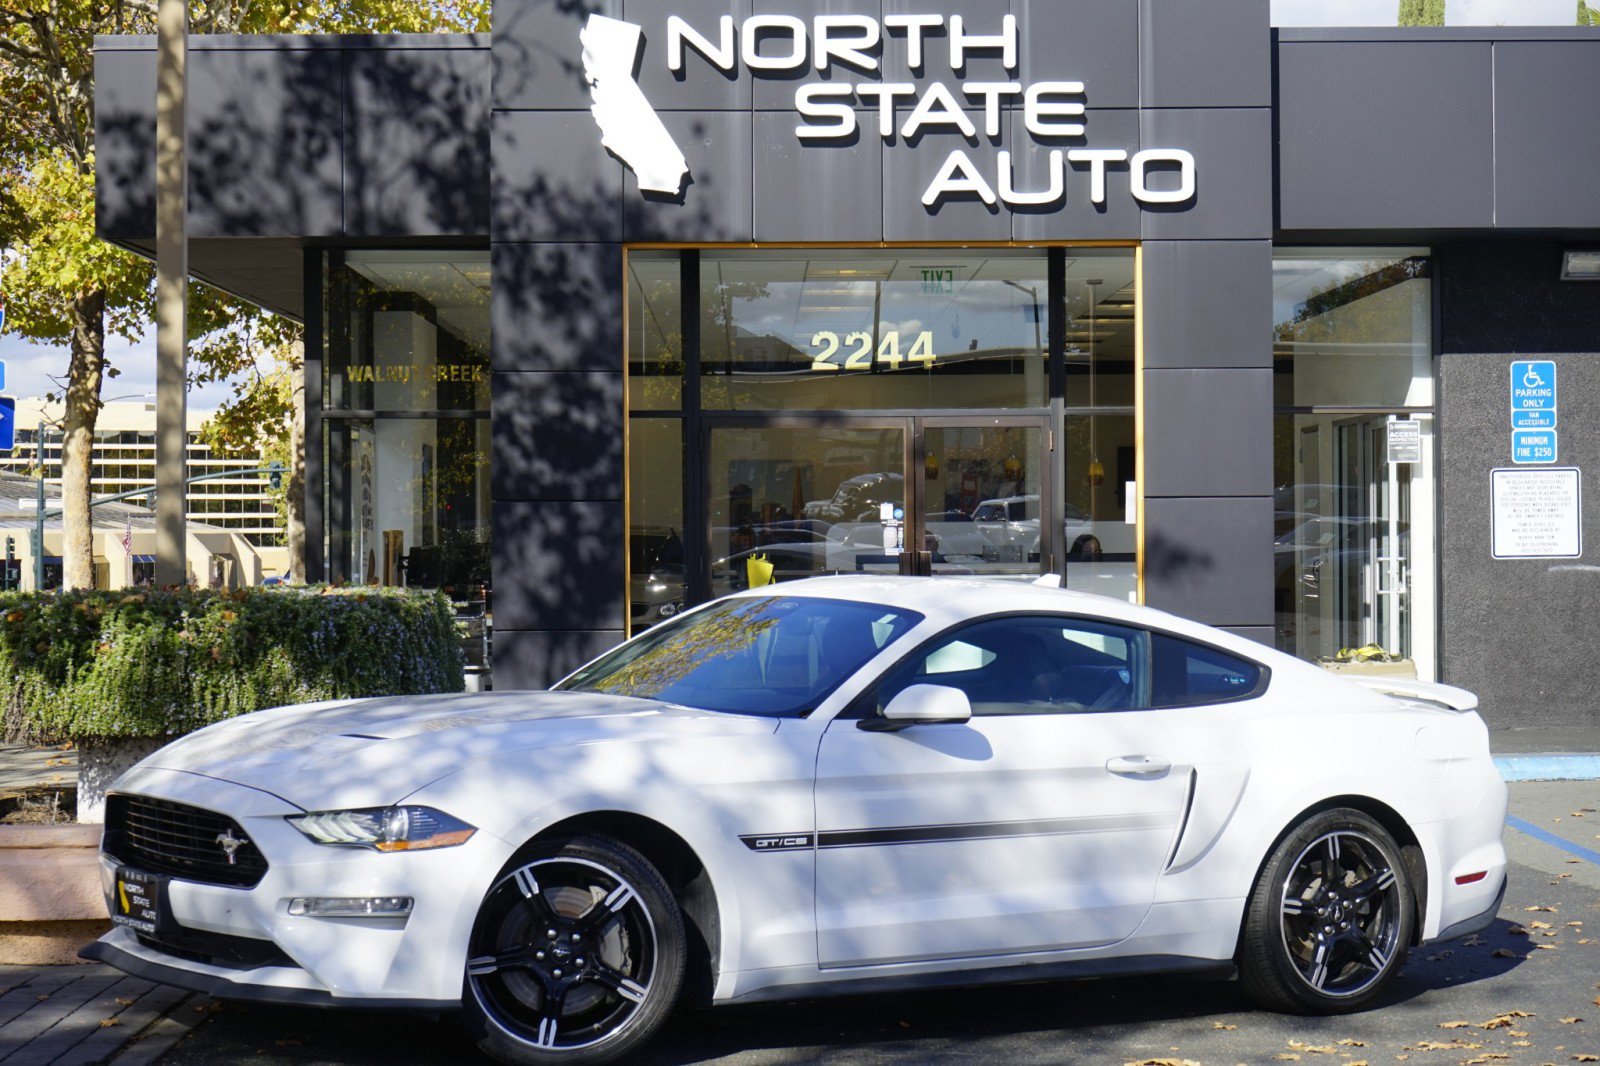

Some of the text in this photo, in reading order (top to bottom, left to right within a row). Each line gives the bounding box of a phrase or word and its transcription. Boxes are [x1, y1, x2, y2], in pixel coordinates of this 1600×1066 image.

[667, 14, 1016, 70] NORTH
[795, 81, 1085, 137] STATE
[921, 148, 1196, 205] AUTO
[811, 331, 937, 370] 2244
[346, 365, 482, 384] WALNUT CREEK
[1515, 389, 1552, 397] PARKING
[1523, 399, 1545, 408] ONLY
[1521, 436, 1548, 445] MINIMUM
[1517, 447, 1552, 458] FINE $250
[756, 837, 807, 847] GT/CS
[124, 883, 145, 896] NORTH
[133, 895, 151, 908] STATE
